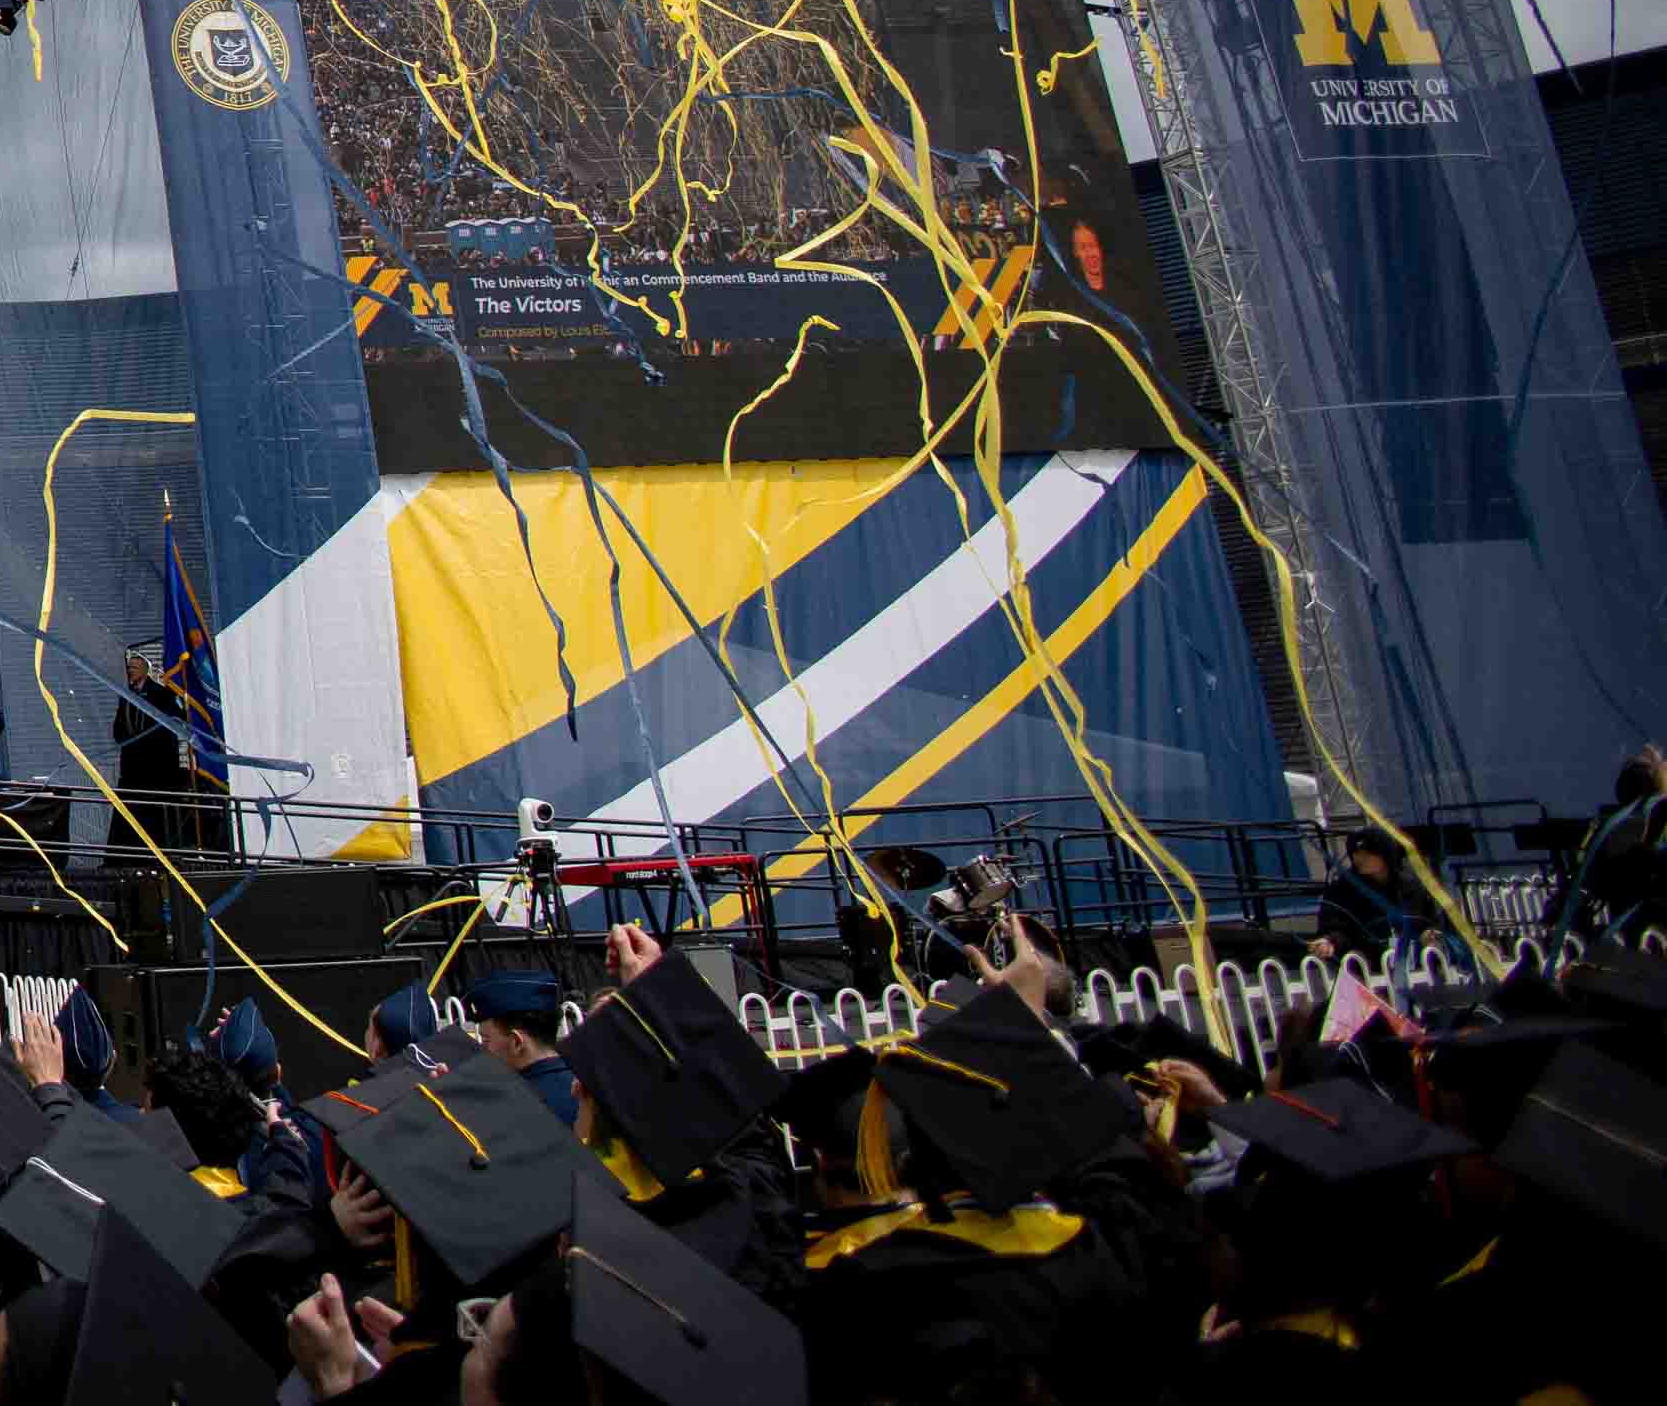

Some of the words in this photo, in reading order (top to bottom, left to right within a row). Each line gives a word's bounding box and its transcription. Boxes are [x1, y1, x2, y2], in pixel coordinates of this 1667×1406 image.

[1311, 78, 1419, 98] UNIVERSITY
[1425, 78, 1449, 95] OF
[1319, 98, 1459, 126] MICHIGAN
[471, 277, 496, 290] The
[499, 276, 562, 291] University
[565, 275, 578, 288] of
[749, 272, 781, 284] Band
[783, 271, 806, 283] and
[808, 270, 829, 282] the
[408, 281, 454, 316] M
[475, 297, 511, 314] The
[515, 296, 582, 314] Victors
[477, 325, 541, 340] Composed
